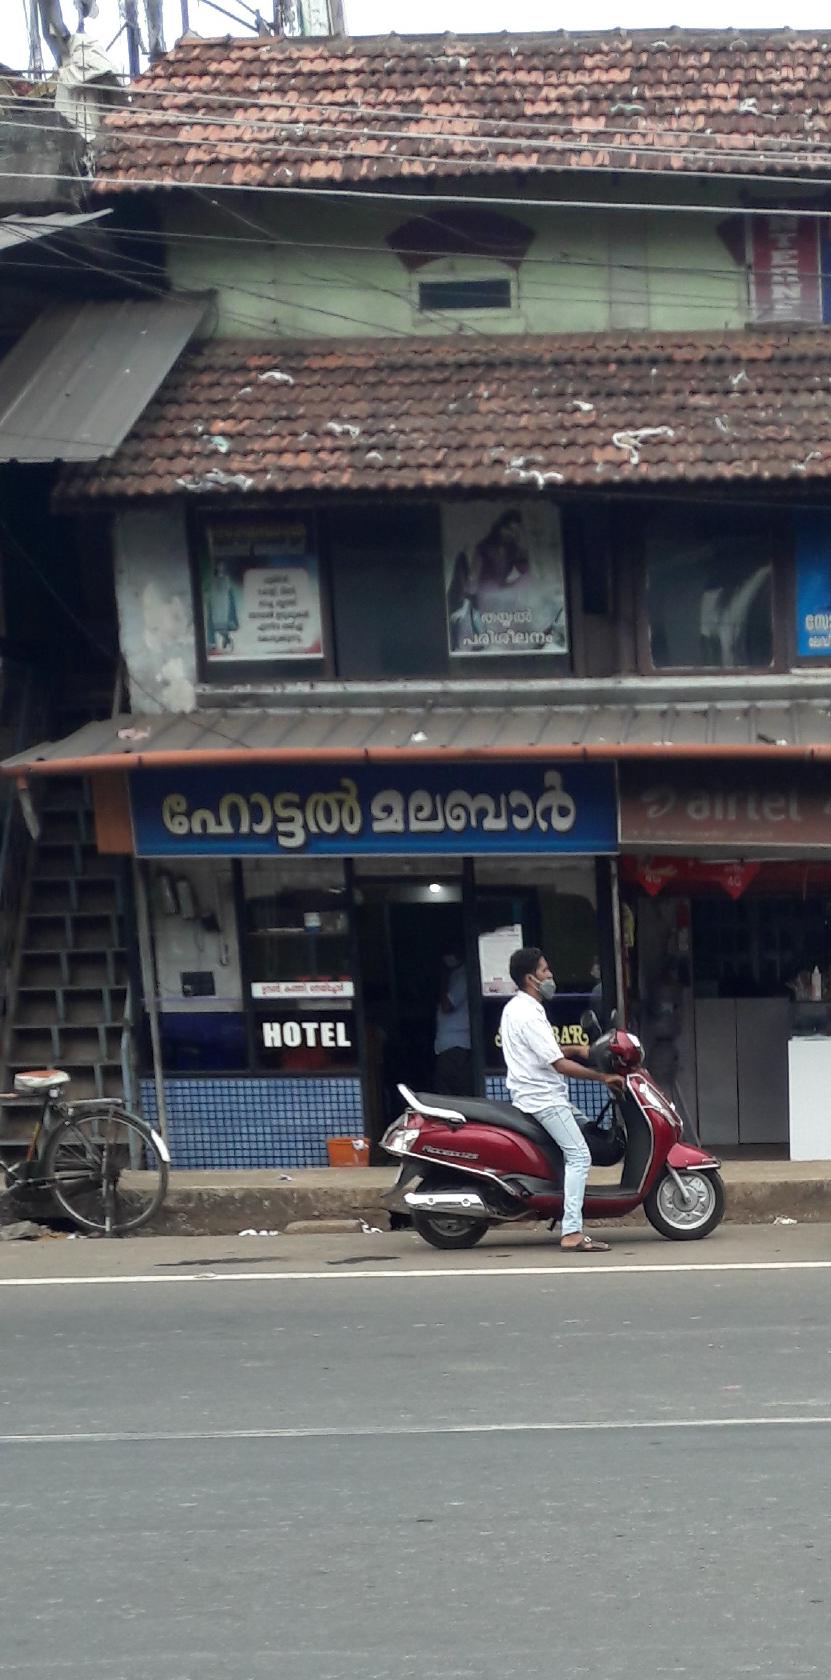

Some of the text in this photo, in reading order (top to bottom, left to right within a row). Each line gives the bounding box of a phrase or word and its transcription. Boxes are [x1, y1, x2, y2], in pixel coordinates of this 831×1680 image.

[162, 770, 576, 848] ഹോട്ടൽ മലബാർ
[686, 786, 803, 822] airtel
[262, 1021, 352, 1048] HOTEL
